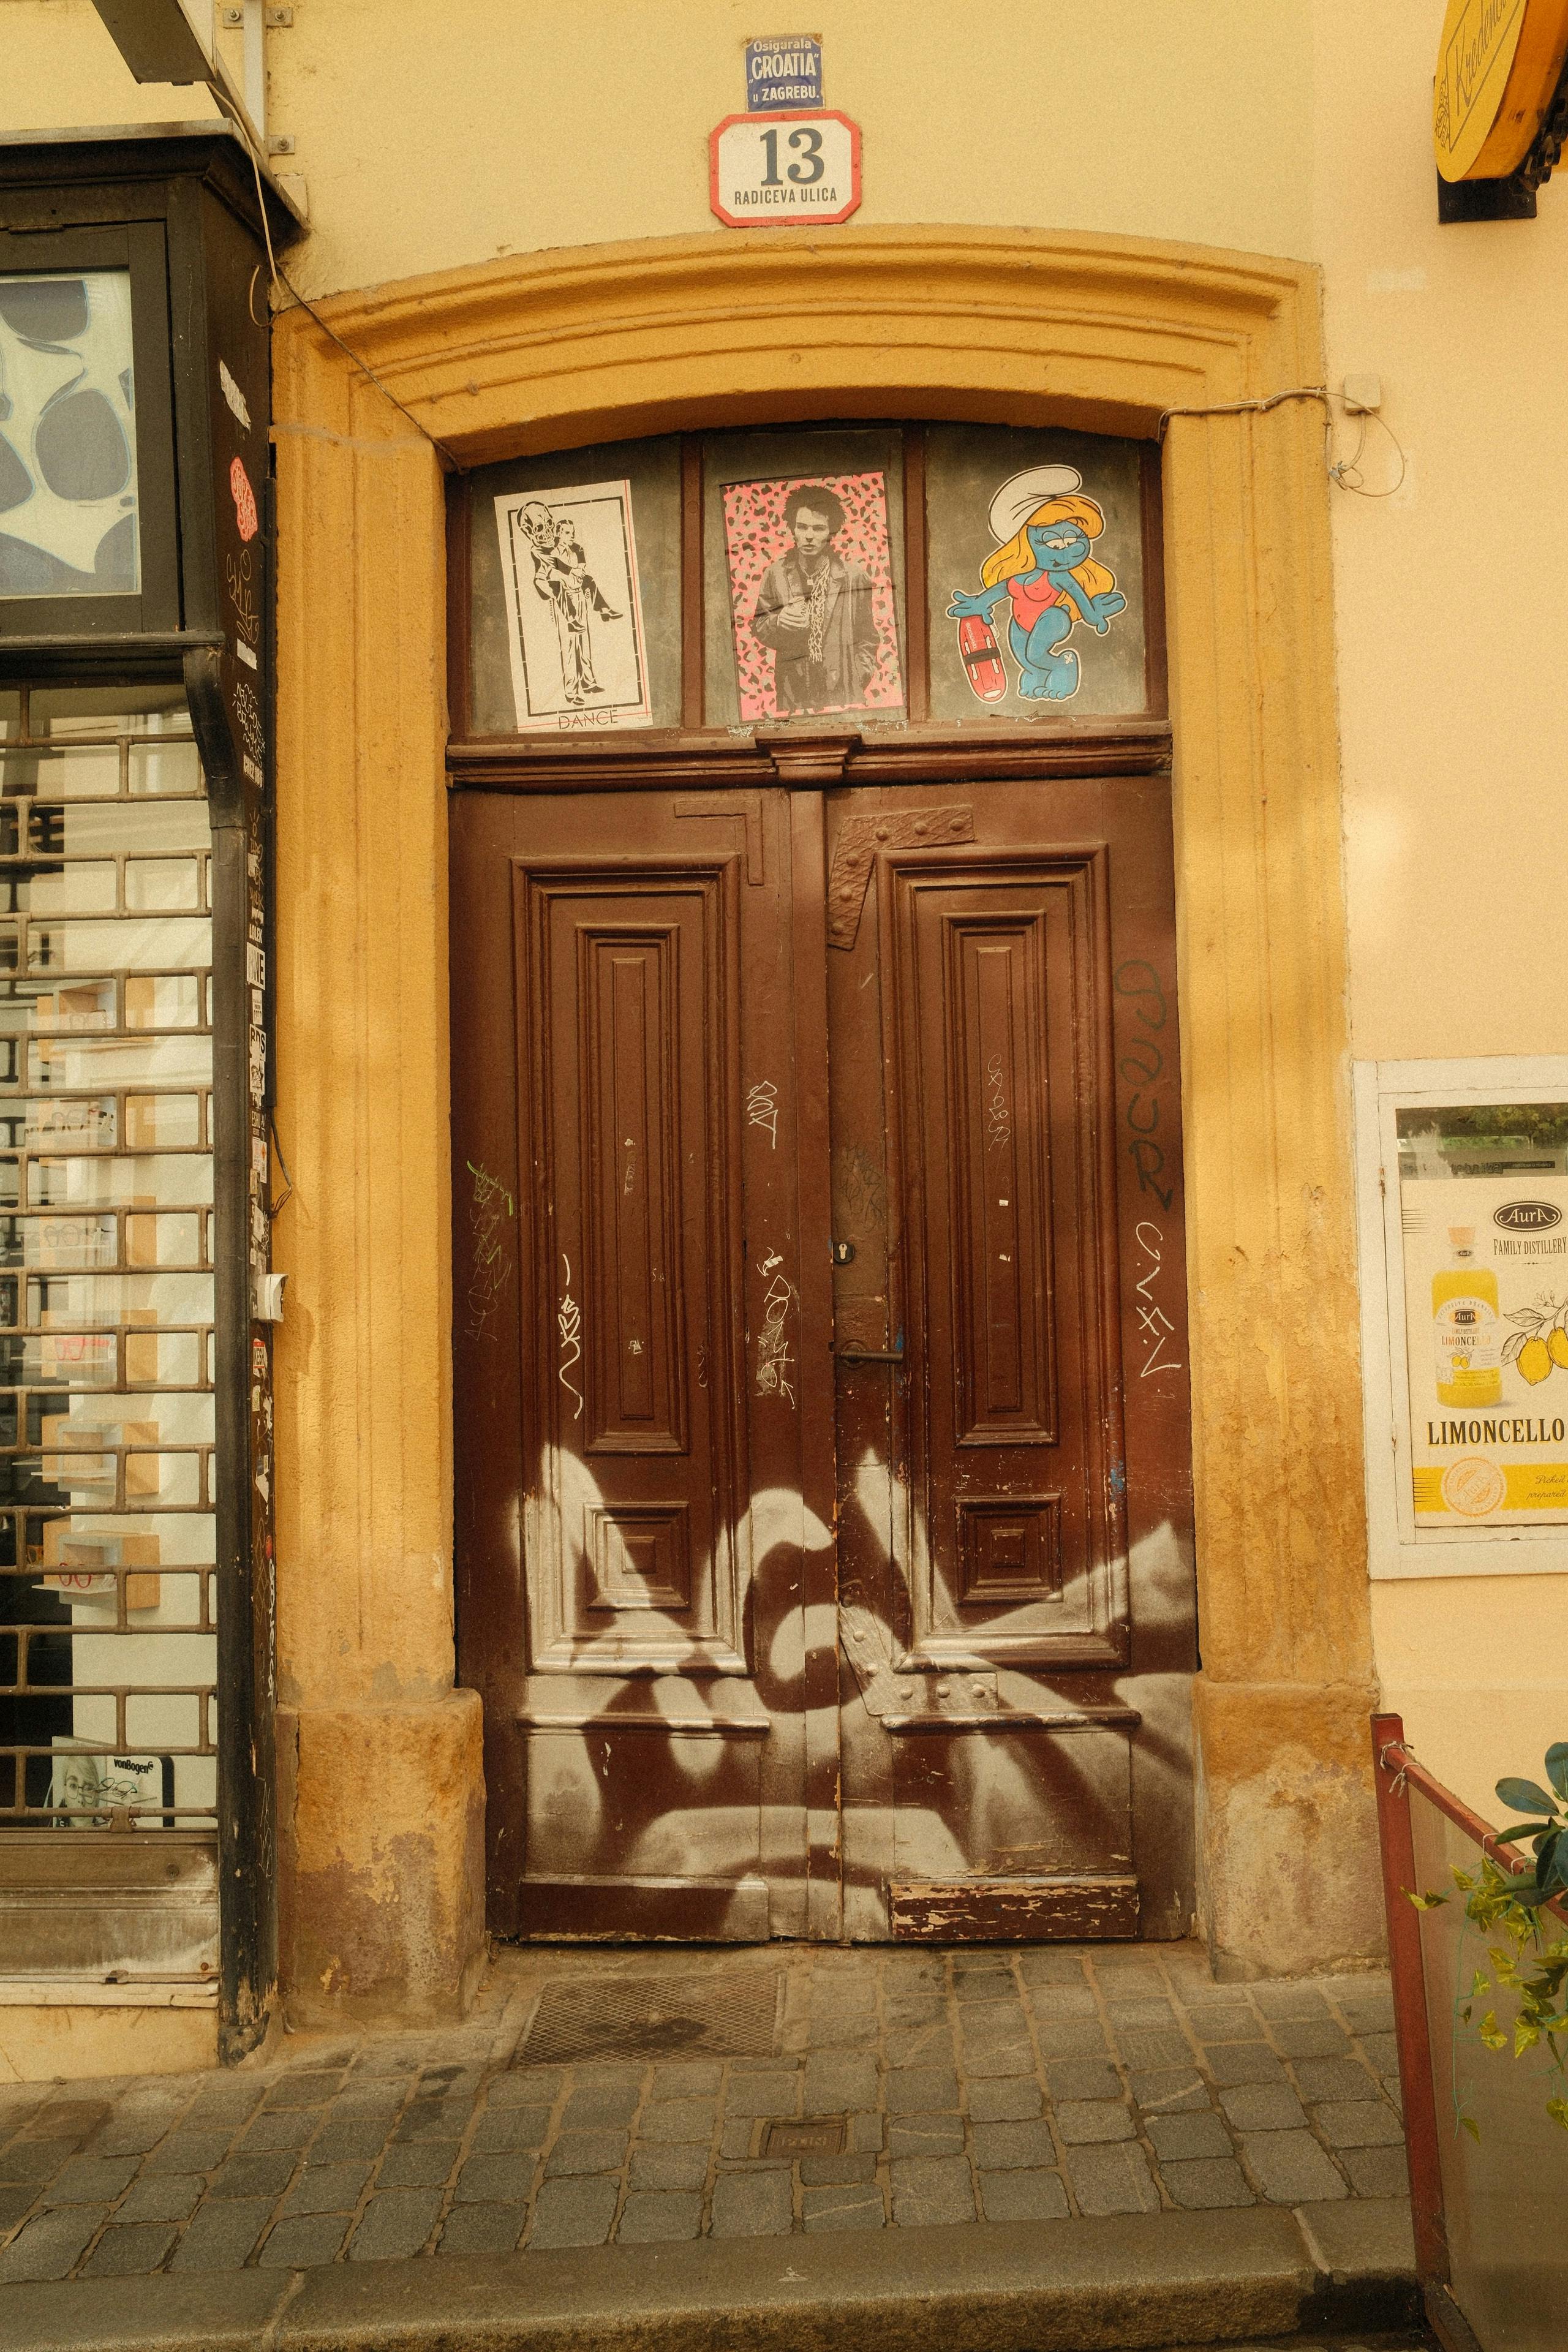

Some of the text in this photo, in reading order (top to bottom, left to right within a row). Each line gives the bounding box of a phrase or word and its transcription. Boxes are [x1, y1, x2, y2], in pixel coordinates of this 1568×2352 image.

[753, 39, 812, 53] Osigurala
[760, 128, 824, 186] 13
[734, 186, 837, 205] RADIĆEVA ULICA
[559, 709, 619, 729] DANCE
[1493, 1237, 1567, 1255] FAMILY DISTILLERY
[1427, 1417, 1566, 1446] LIMONCELLO
[1534, 1474, 1566, 1485] Picked
[1526, 1488, 1566, 1501] prepared
